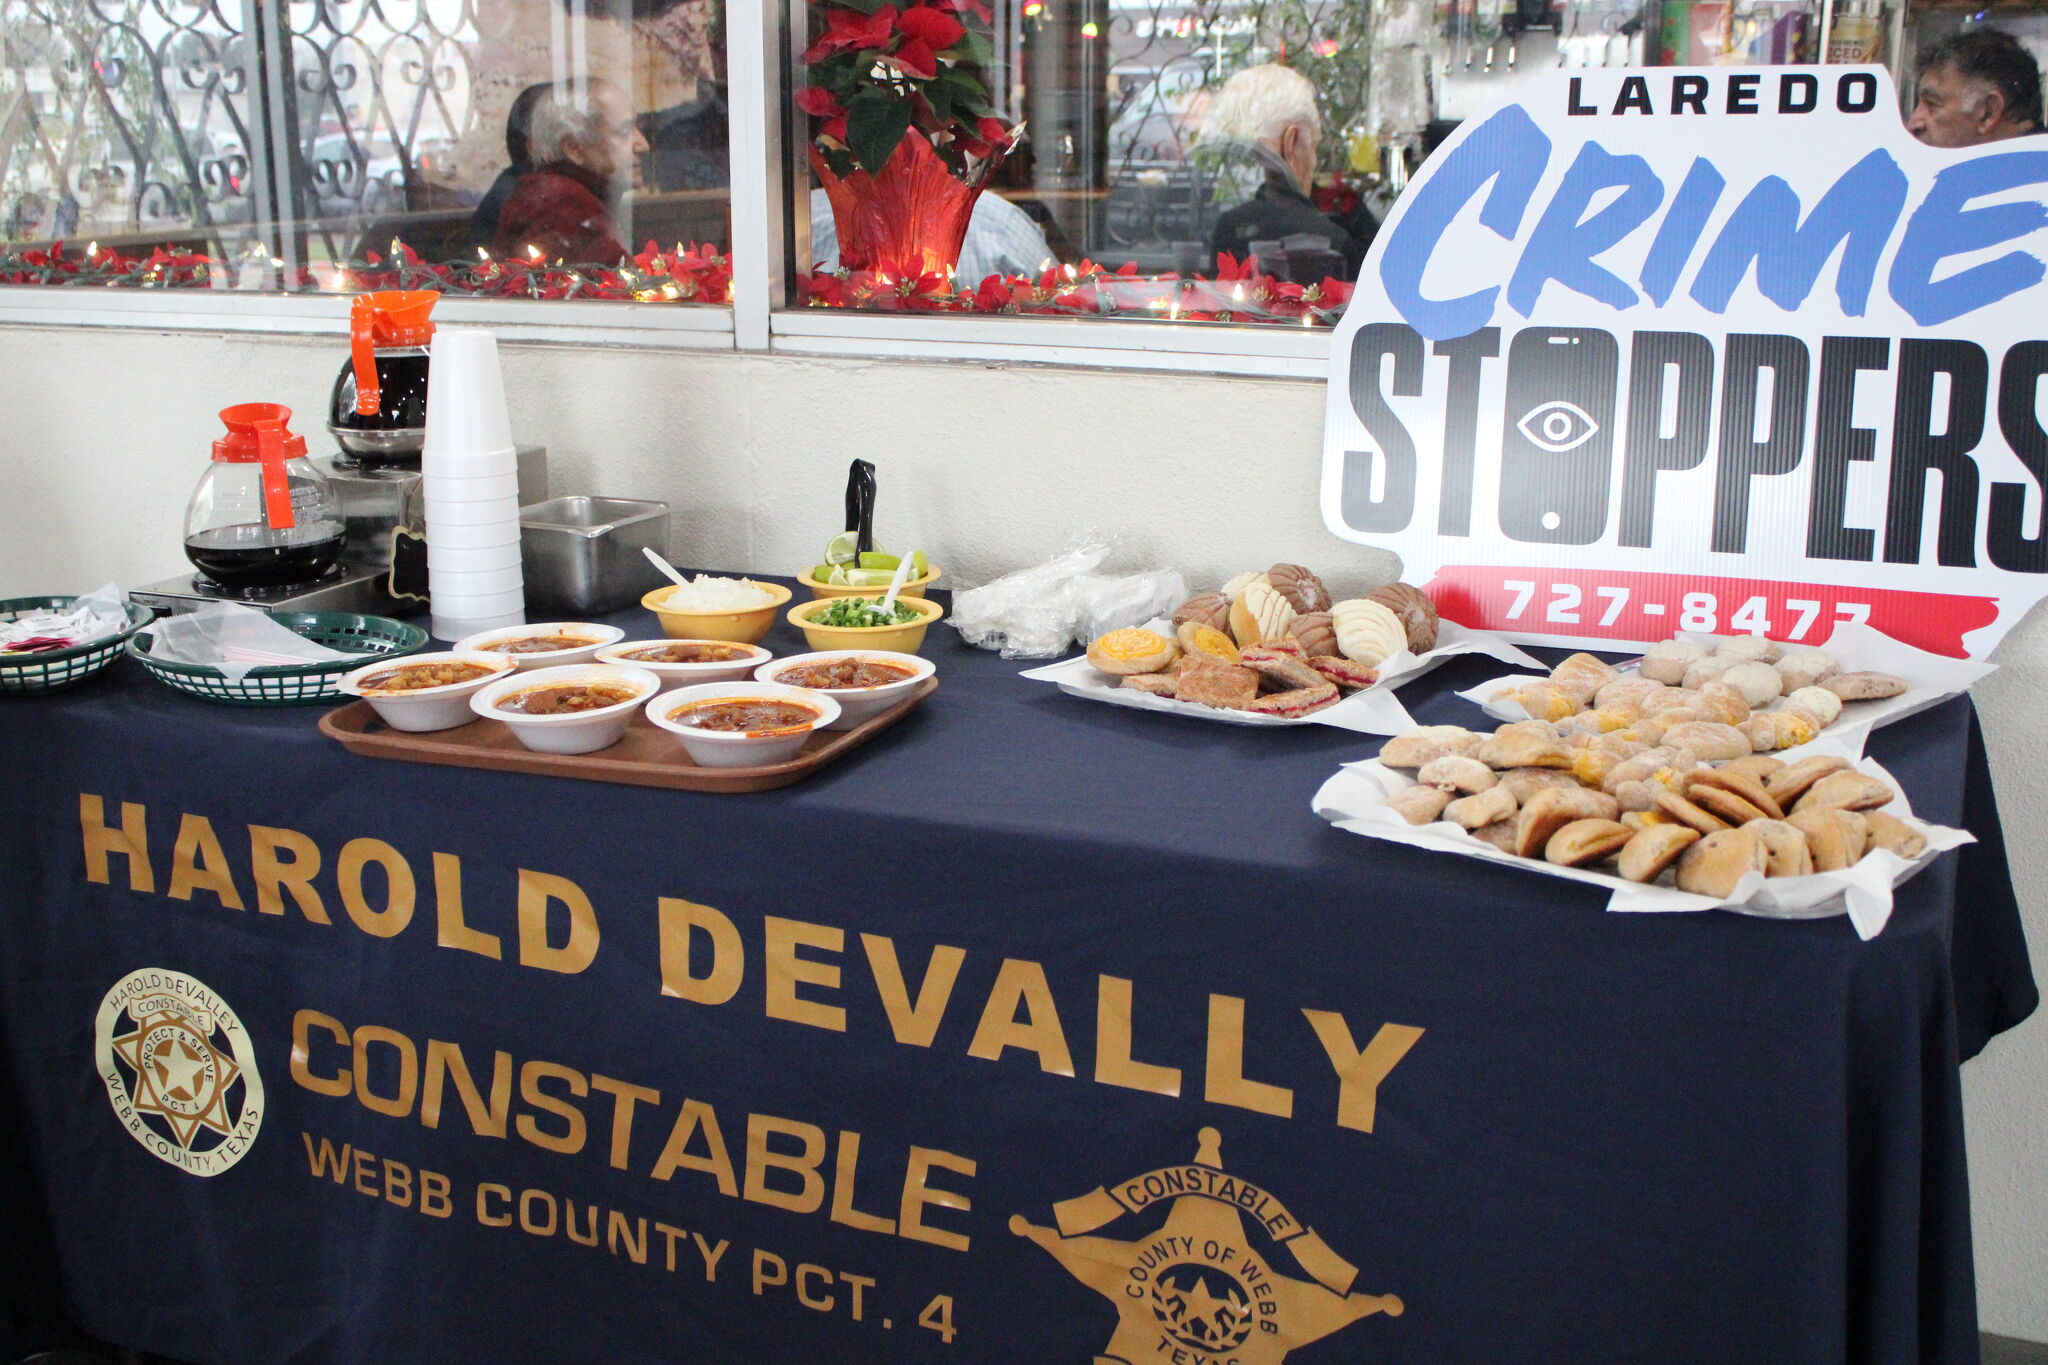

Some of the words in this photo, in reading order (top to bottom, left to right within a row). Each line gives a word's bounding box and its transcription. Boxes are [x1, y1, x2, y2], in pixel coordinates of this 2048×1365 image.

[1567, 72, 1878, 116] LAREDO
[1379, 103, 2048, 341] CRIME
[79, 792, 601, 974] HAROLD
[657, 897, 1426, 1134] DEVALLY
[110, 974, 161, 1011] HAROLD
[165, 976, 239, 1032] DEVALLEY
[137, 997, 204, 1027] CONSTABLE
[143, 1028, 175, 1070] PROTECT
[178, 1031, 187, 1042] &
[189, 1038, 214, 1084] SERVE
[107, 1072, 141, 1132] WEBB
[145, 1133, 216, 1173] COUNTY,
[217, 1109, 259, 1164] TEXAS
[161, 1094, 192, 1114] PCT.
[289, 1009, 978, 1252] CONSTABLE
[301, 1132, 453, 1219] WEBB
[476, 1182, 730, 1283] COUNTY
[753, 1248, 892, 1329] PCT.
[918, 1294, 958, 1345] 4
[1126, 1168, 1292, 1236] CONSTABLE
[1125, 1236, 1194, 1299] COUNTY
[1204, 1240, 1236, 1264] OF
[1240, 1258, 1279, 1335] WEBB
